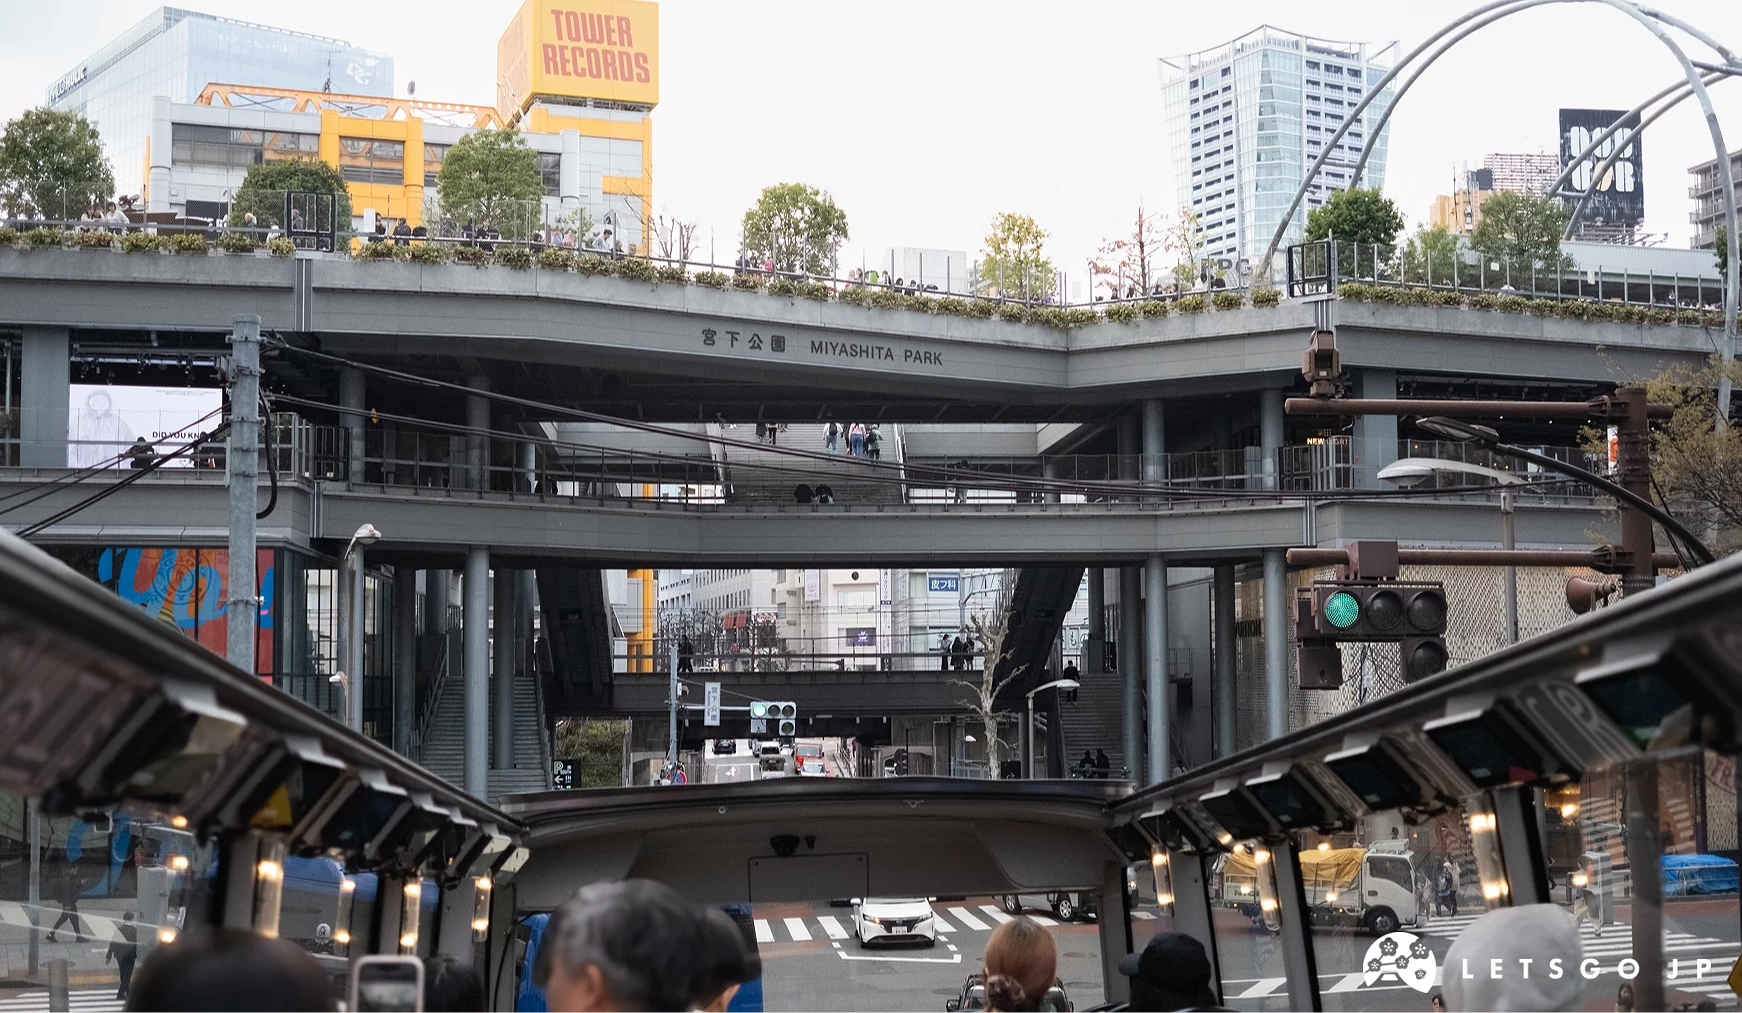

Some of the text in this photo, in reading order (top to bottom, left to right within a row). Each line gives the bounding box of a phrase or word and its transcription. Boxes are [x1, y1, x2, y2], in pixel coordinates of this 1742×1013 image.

[551, 9, 633, 48] TOWER
[542, 43, 651, 83] RECORDS
[702, 327, 943, 366] 宮下公園 MIYASHITA PARK
[152, 431, 167, 439] DID
[169, 431, 186, 439] YOU
[1306, 437, 1325, 445] NEW
[931, 579, 957, 590] 皮フ科
